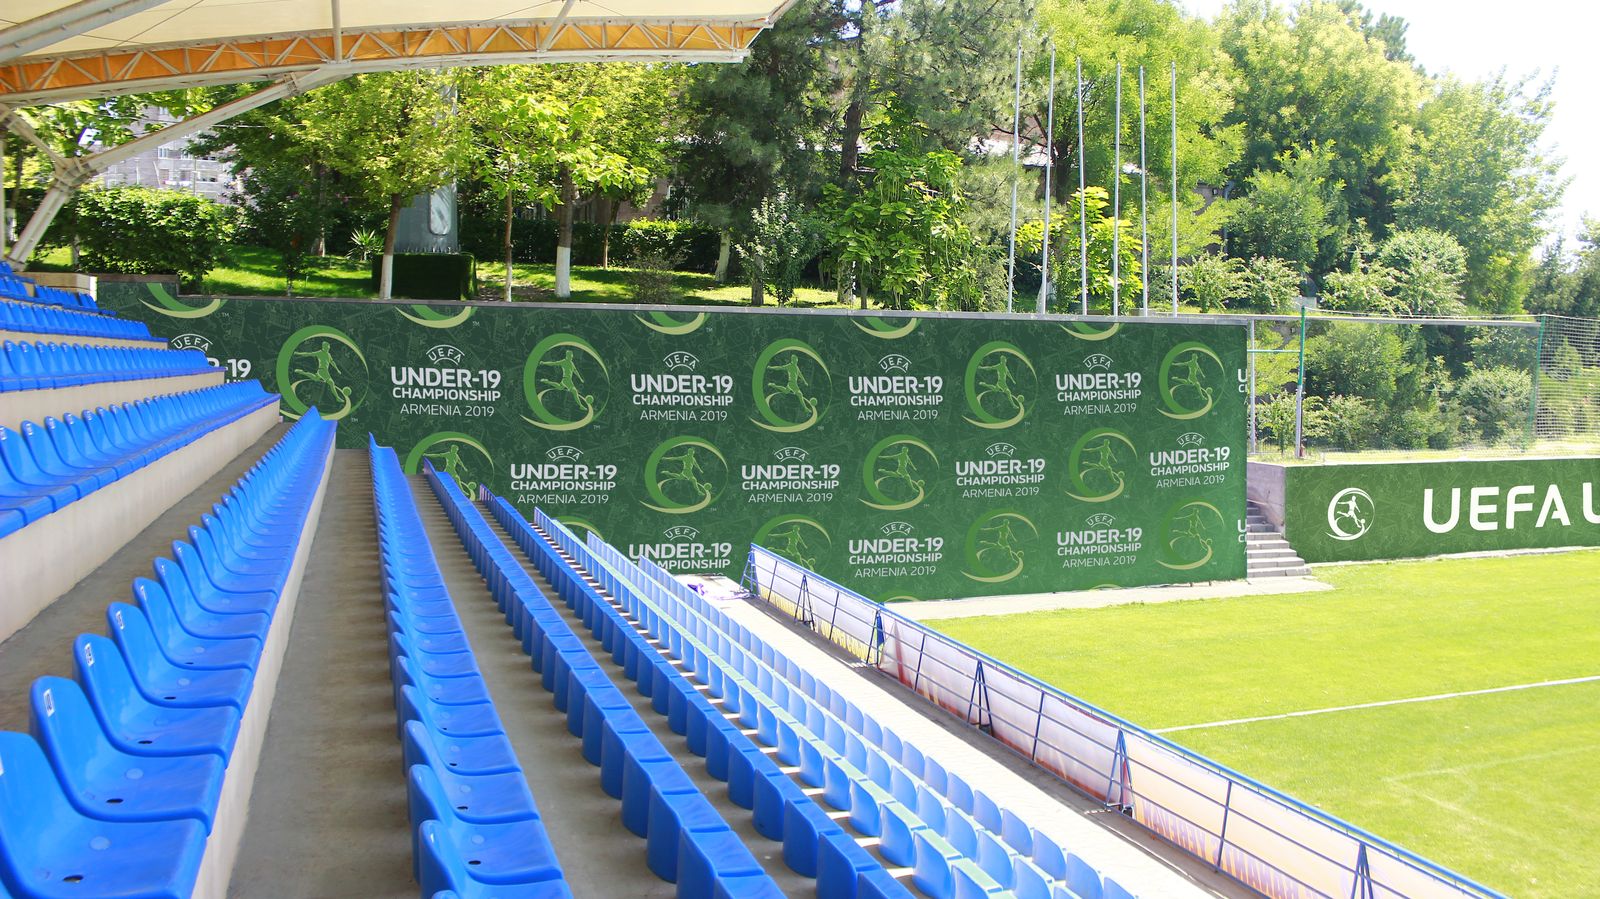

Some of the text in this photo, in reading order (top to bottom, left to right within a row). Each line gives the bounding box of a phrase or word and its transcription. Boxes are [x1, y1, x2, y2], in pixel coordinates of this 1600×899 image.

[173, 336, 209, 351] UEFA
[428, 348, 462, 362] UEFA
[665, 353, 697, 368] UEFA
[880, 356, 909, 369] UEFA
[1084, 356, 1111, 369] UEFA
[391, 367, 501, 388] UNDER-19
[631, 374, 733, 393] UNDER-19
[1056, 373, 1141, 390] UNDER-19
[849, 376, 943, 394] UNDER-19
[393, 387, 500, 401] CHAMPIONSHIP
[633, 394, 733, 405] CHAMPIONSHIP
[1058, 390, 1141, 401] CHAMPIONSHIP
[851, 395, 943, 406] CHAMPIONSHIP
[400, 404, 494, 416] ARMENIA 2019
[858, 410, 938, 420] ARMENIA 2019
[1064, 403, 1136, 415] ARMENIA 2019
[640, 410, 727, 421] ARMENIA 2019
[1178, 434, 1203, 446] UEFA
[547, 448, 580, 461] UEFA
[776, 449, 805, 461] UEFA
[987, 444, 1014, 455] UEFA
[1150, 447, 1230, 465] UNDER-19
[511, 464, 617, 479] UNDER-19
[742, 465, 840, 479] UNDER-19
[956, 459, 1045, 475] UNDER-19
[1151, 461, 1230, 476] CHAMPIONSHIP
[511, 481, 615, 490] CHAMPIONSHIP
[743, 480, 839, 490] CHAMPIONSHIP
[957, 474, 1044, 485] CHAMPIONSHIP
[1156, 475, 1224, 488] ARMENIA 2019
[518, 494, 608, 503] ARMENIA 2019
[748, 493, 832, 502] ARMENIA 2019
[963, 487, 1039, 498] ARMENIA 2019
[1423, 484, 1571, 534] UEFA
[1087, 514, 1113, 526] UEFA
[665, 527, 697, 539] UEFA
[882, 523, 911, 535] UEFA
[1057, 528, 1142, 545] UNDER-19
[629, 542, 732, 560] UNDER-19
[849, 538, 943, 554] UNDER-19
[1058, 543, 1141, 555] CHAMPIONSHIP
[632, 559, 731, 570] MPIONSHIP
[849, 553, 942, 564] CHAMPIONSHIP
[1063, 555, 1136, 568] ARMENIA 2019
[855, 566, 936, 577] ARMENIA 2019
